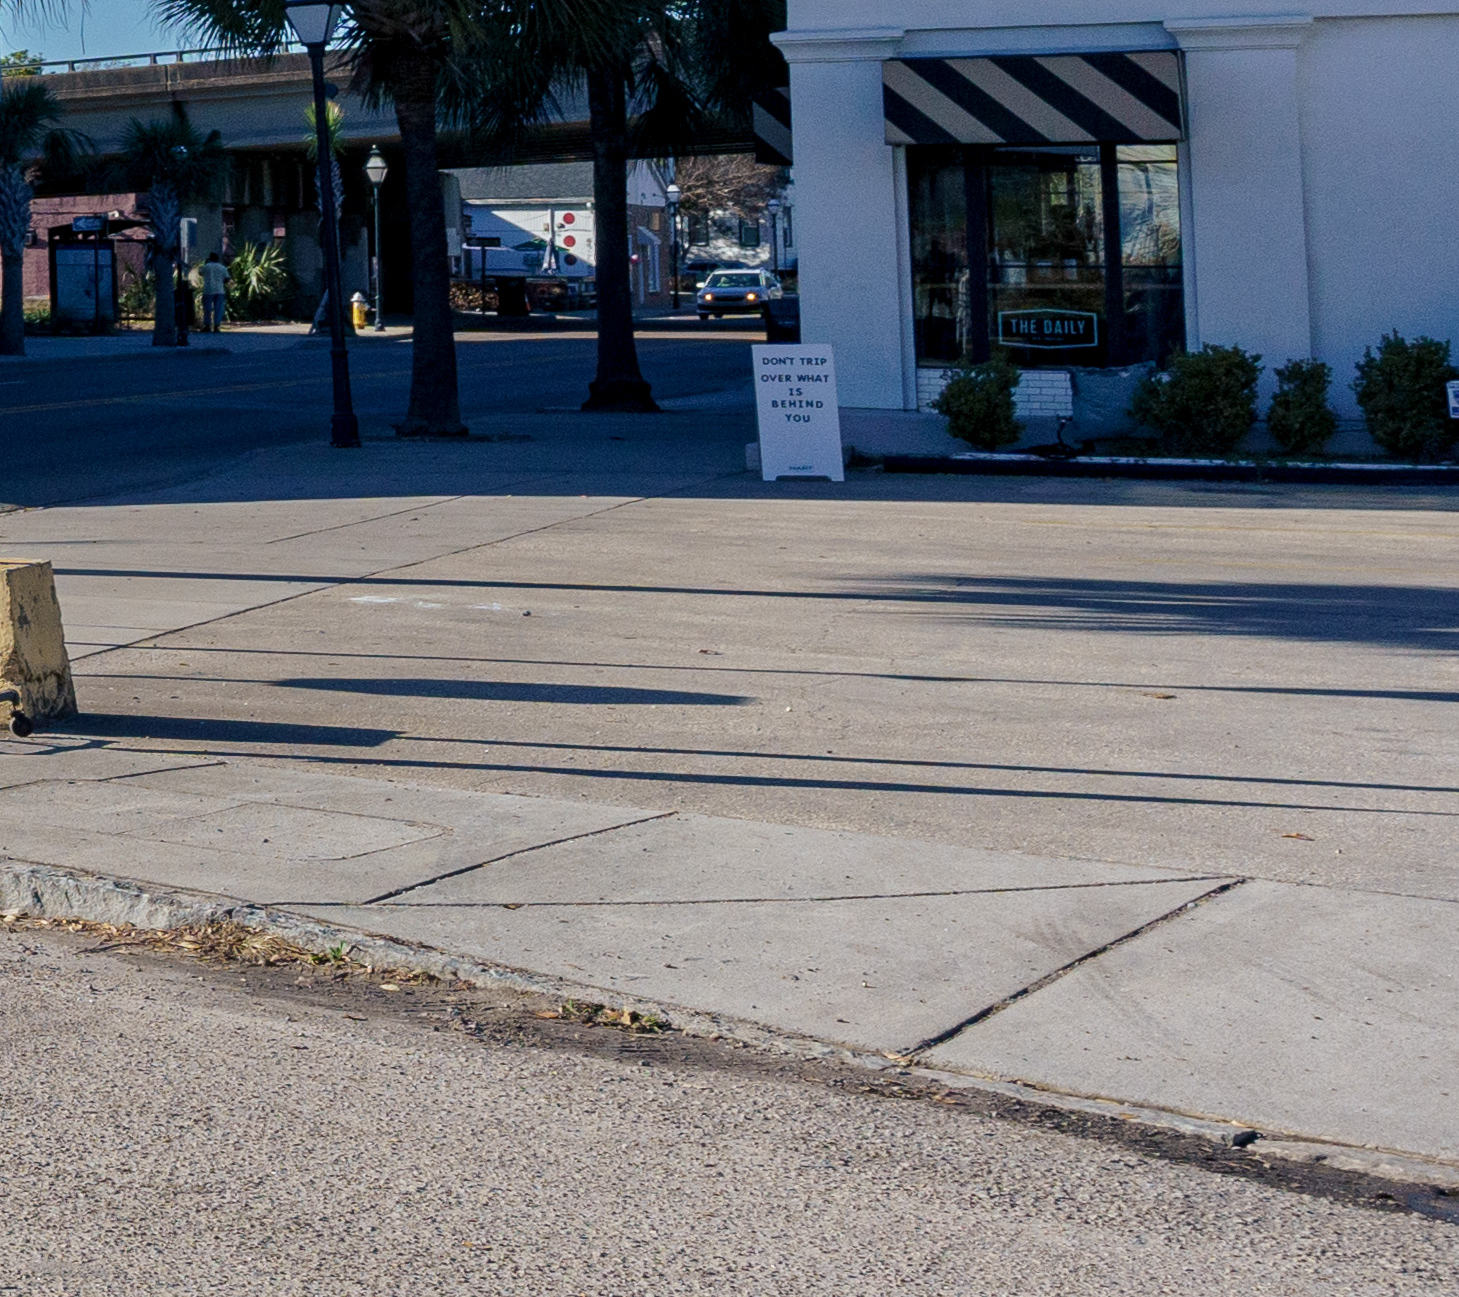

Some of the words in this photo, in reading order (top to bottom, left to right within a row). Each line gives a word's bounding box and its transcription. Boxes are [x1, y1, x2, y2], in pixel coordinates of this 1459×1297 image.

[1010, 318, 1038, 334] THE
[1043, 319, 1086, 335] DAILY
[762, 356, 795, 366] DON'T
[800, 357, 828, 366] TRIP
[760, 374, 792, 383] OVER
[796, 374, 829, 383] WHAT
[788, 388, 803, 396] IS
[771, 399, 824, 409] BEHIND
[784, 413, 811, 423] YOU
